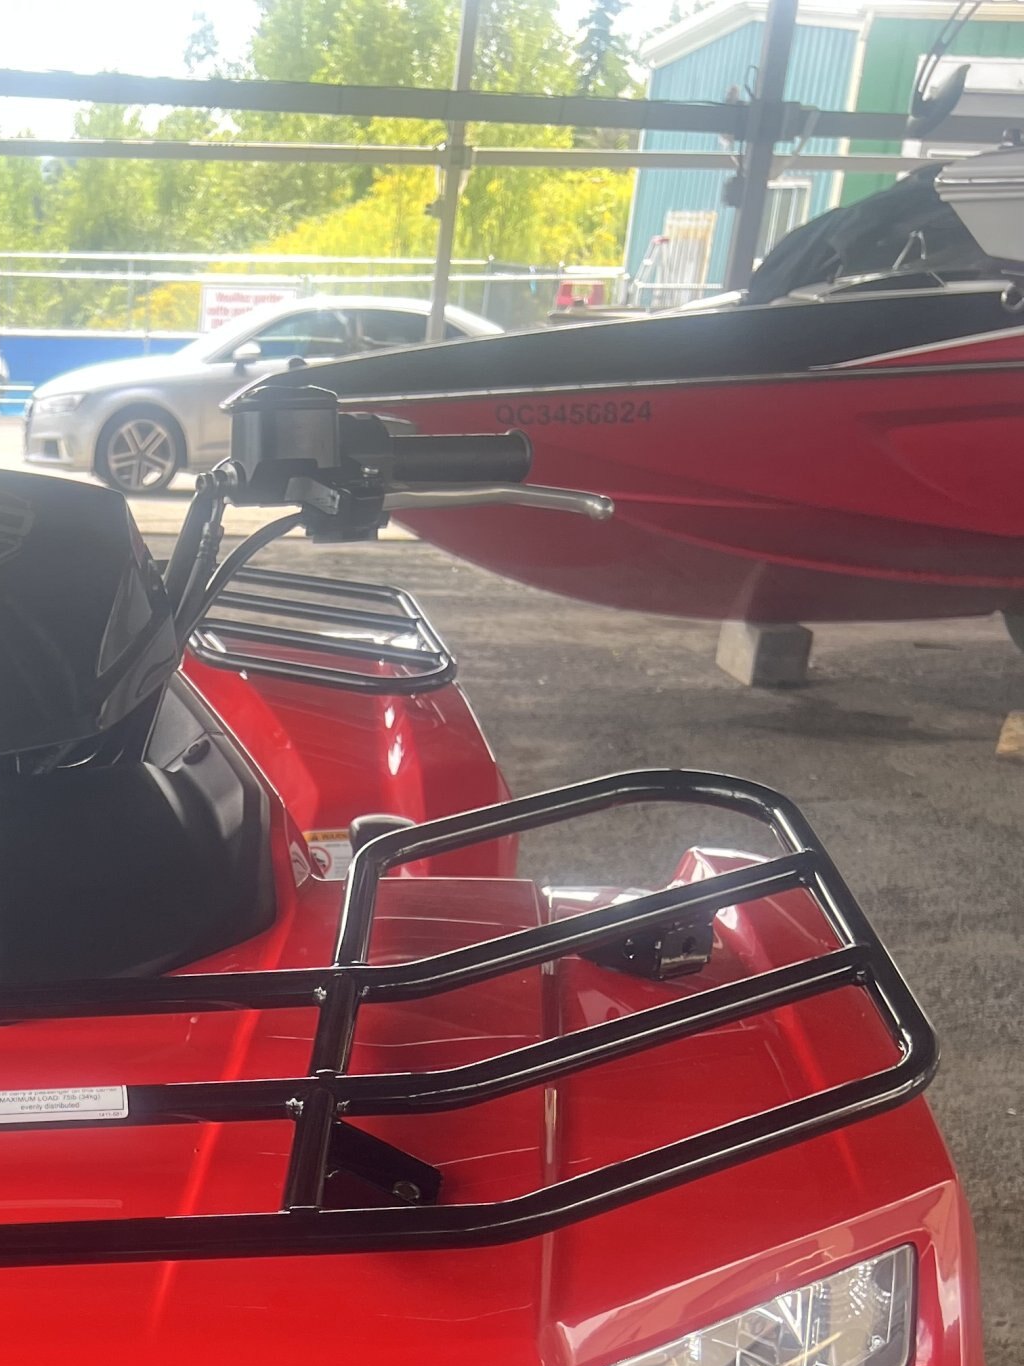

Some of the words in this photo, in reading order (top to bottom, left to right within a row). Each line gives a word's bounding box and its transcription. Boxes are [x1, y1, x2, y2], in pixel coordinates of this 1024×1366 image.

[0, 1095, 36, 1104] MAXIMUM
[20, 1103, 43, 1111] evenly
[44, 1102, 80, 1110] distributed
